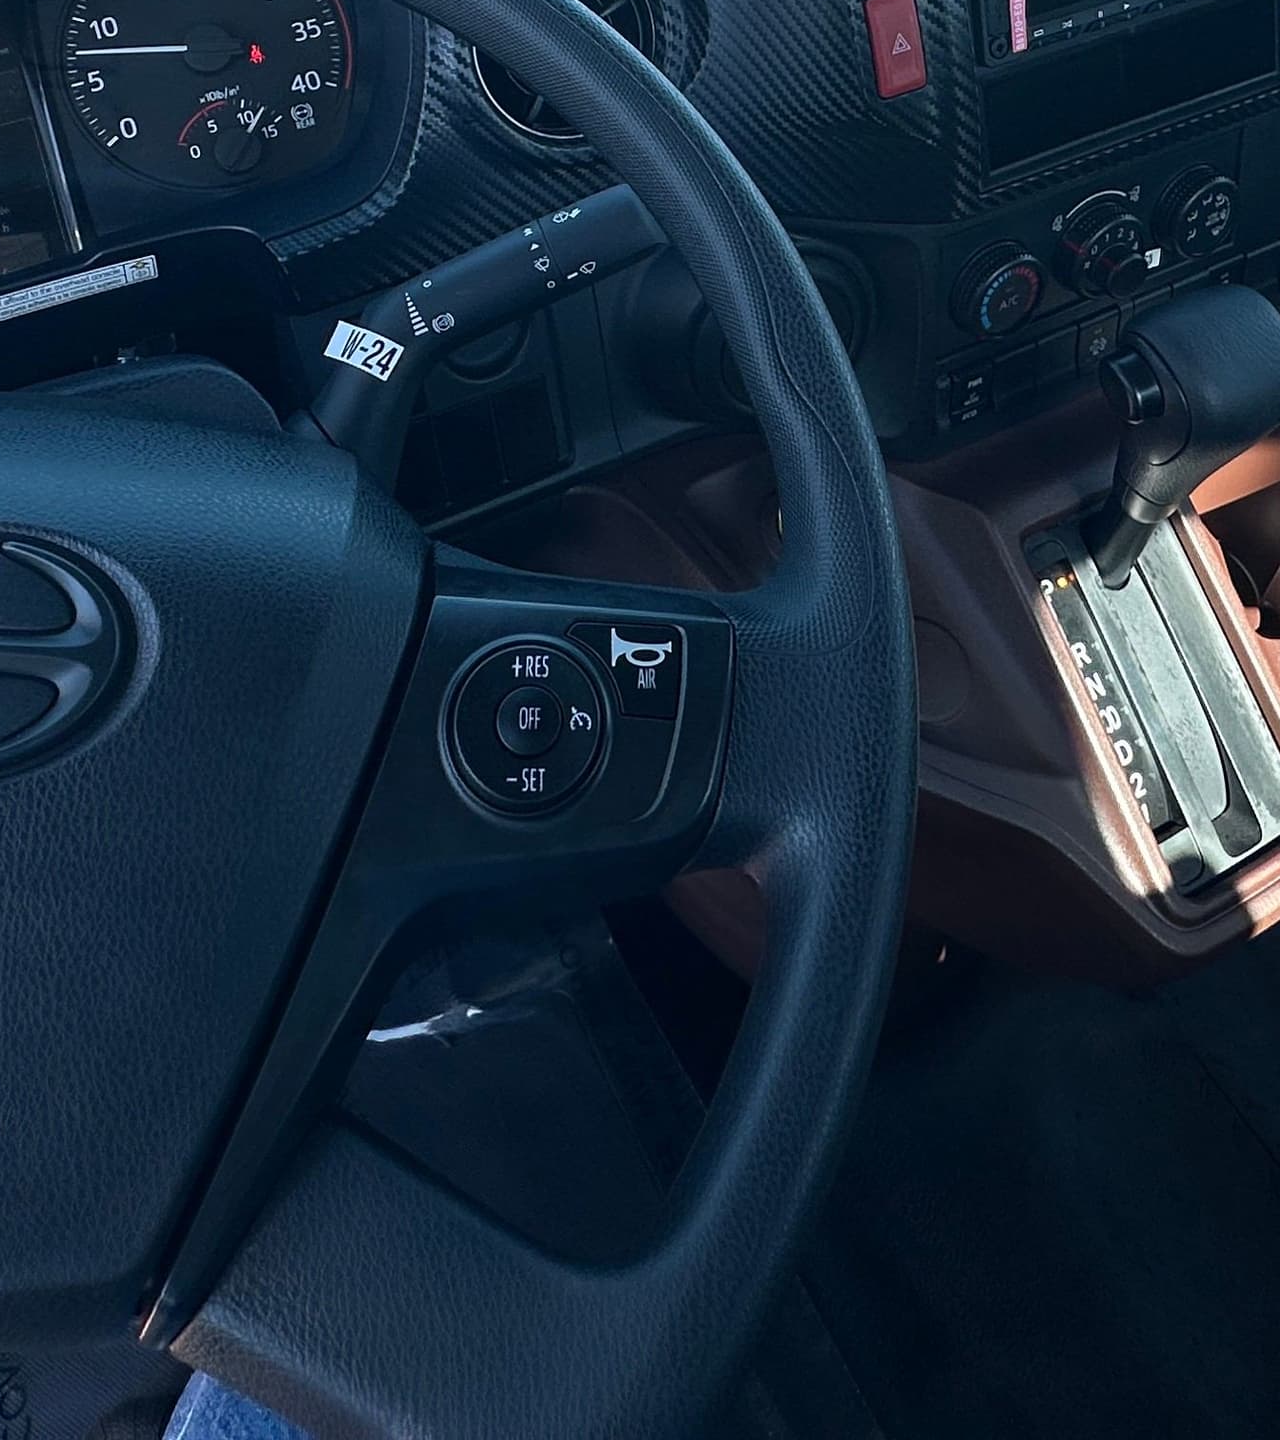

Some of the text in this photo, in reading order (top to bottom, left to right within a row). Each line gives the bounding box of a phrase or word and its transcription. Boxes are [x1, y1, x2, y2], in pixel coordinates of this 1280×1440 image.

[89, 16, 119, 39] 10
[291, 18, 322, 42] 35
[87, 70, 105, 92] 5
[291, 70, 321, 93] 40
[119, 117, 138, 139] 0
[207, 120, 218, 134] 5
[237, 110, 254, 125] 10
[295, 118, 316, 129] REAR
[262, 125, 278, 139] 15
[189, 145, 201, 159] 0
[52, 276, 88, 290] overhead
[1000, 294, 1020, 312] A/C
[340, 328, 399, 376] W-24
[1071, 642, 1092, 668] R
[637, 668, 656, 689] AIR
[1084, 672, 1106, 700] N
[519, 707, 541, 730] OFF
[1113, 740, 1133, 766] D
[1129, 772, 1147, 798] 2
